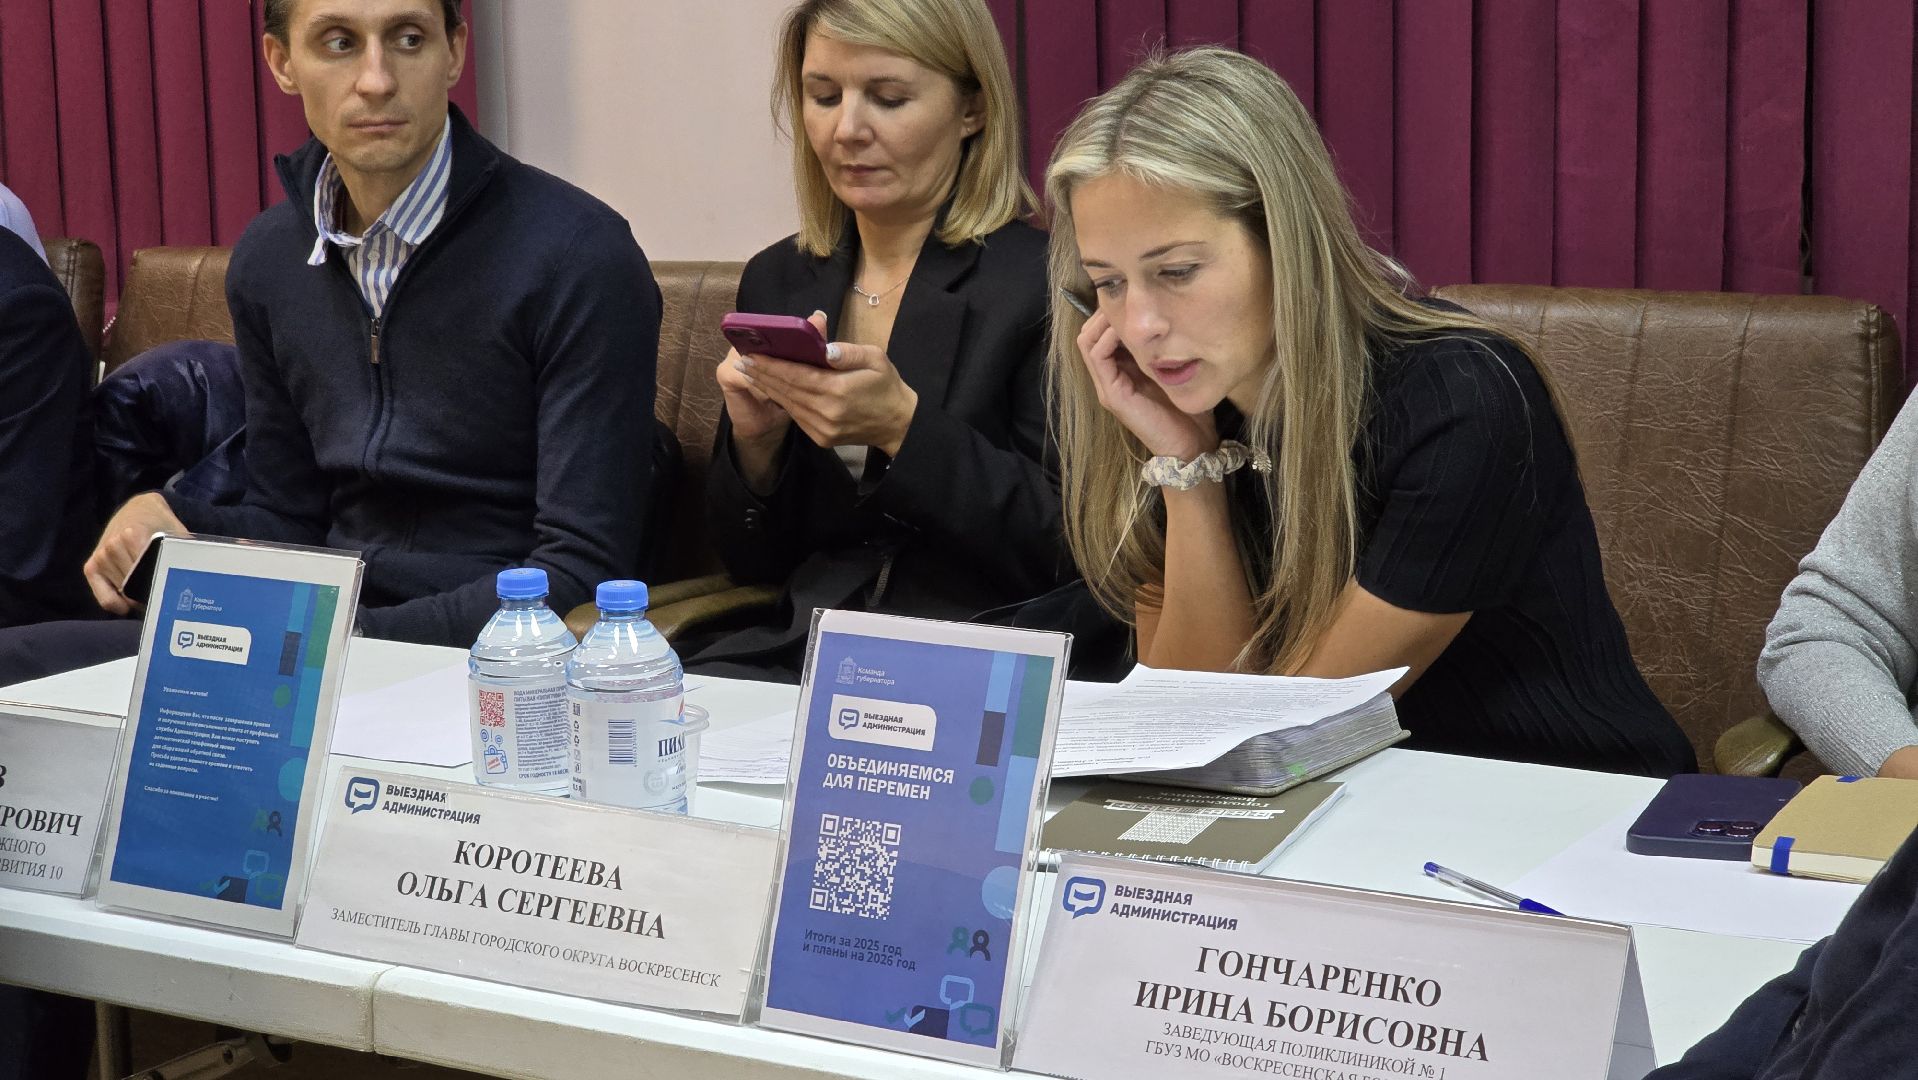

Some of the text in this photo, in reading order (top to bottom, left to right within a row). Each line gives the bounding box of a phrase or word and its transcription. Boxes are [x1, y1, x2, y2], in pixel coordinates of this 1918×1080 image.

[196, 642, 243, 652] АДМИНИСТРАЦИЯ
[197, 634, 226, 643] ВЫЕЗДНАЯ
[856, 675, 895, 686] губернатора
[858, 667, 886, 676] Команда
[862, 722, 926, 736] АДМИНИСТРАЦИЯ
[864, 712, 903, 724] ВЫЕЗДНАЯ
[827, 754, 954, 784] ОБЪЕДИНЯЕМСЯ
[386, 784, 448, 804] ВЫЕЗДНАЯ
[822, 772, 930, 800] ДЛЯ ПЕРЕМЕН
[0, 804, 83, 836] РОВИЧ
[382, 801, 480, 824] АДМИНИСТРАЦИЯ
[49, 866, 63, 880] 10
[453, 840, 623, 890] КОРОТЕЕВА
[397, 872, 665, 939] ОЛЬГА СЕРГЕЕВНА
[1114, 885, 1192, 906] ВЫЕЗДНАЯ
[1110, 902, 1238, 930] АДМИНИСТРАЦИЯ
[331, 908, 721, 987] ЗАМЕСТИТЕЛЬ ГЛАВЫ ГОРОДСКОГО ОКРУГА ВОСКРЕСЕНСК
[804, 928, 902, 957] Итоги за 2025 год
[802, 942, 916, 972] и планы на 2026 год
[1195, 946, 1442, 1007] ГОНЧАРЕНКО
[1133, 980, 1488, 1062] ИРИНА БОРИСОВНА
[1146, 1040, 1182, 1058] ГБУЗ
[1185, 1047, 1210, 1063] МО
[1164, 1022, 1446, 1080] ЗАВЕДУЮЩАЯ ПОЛИКЛИНИКОЙ № 1
